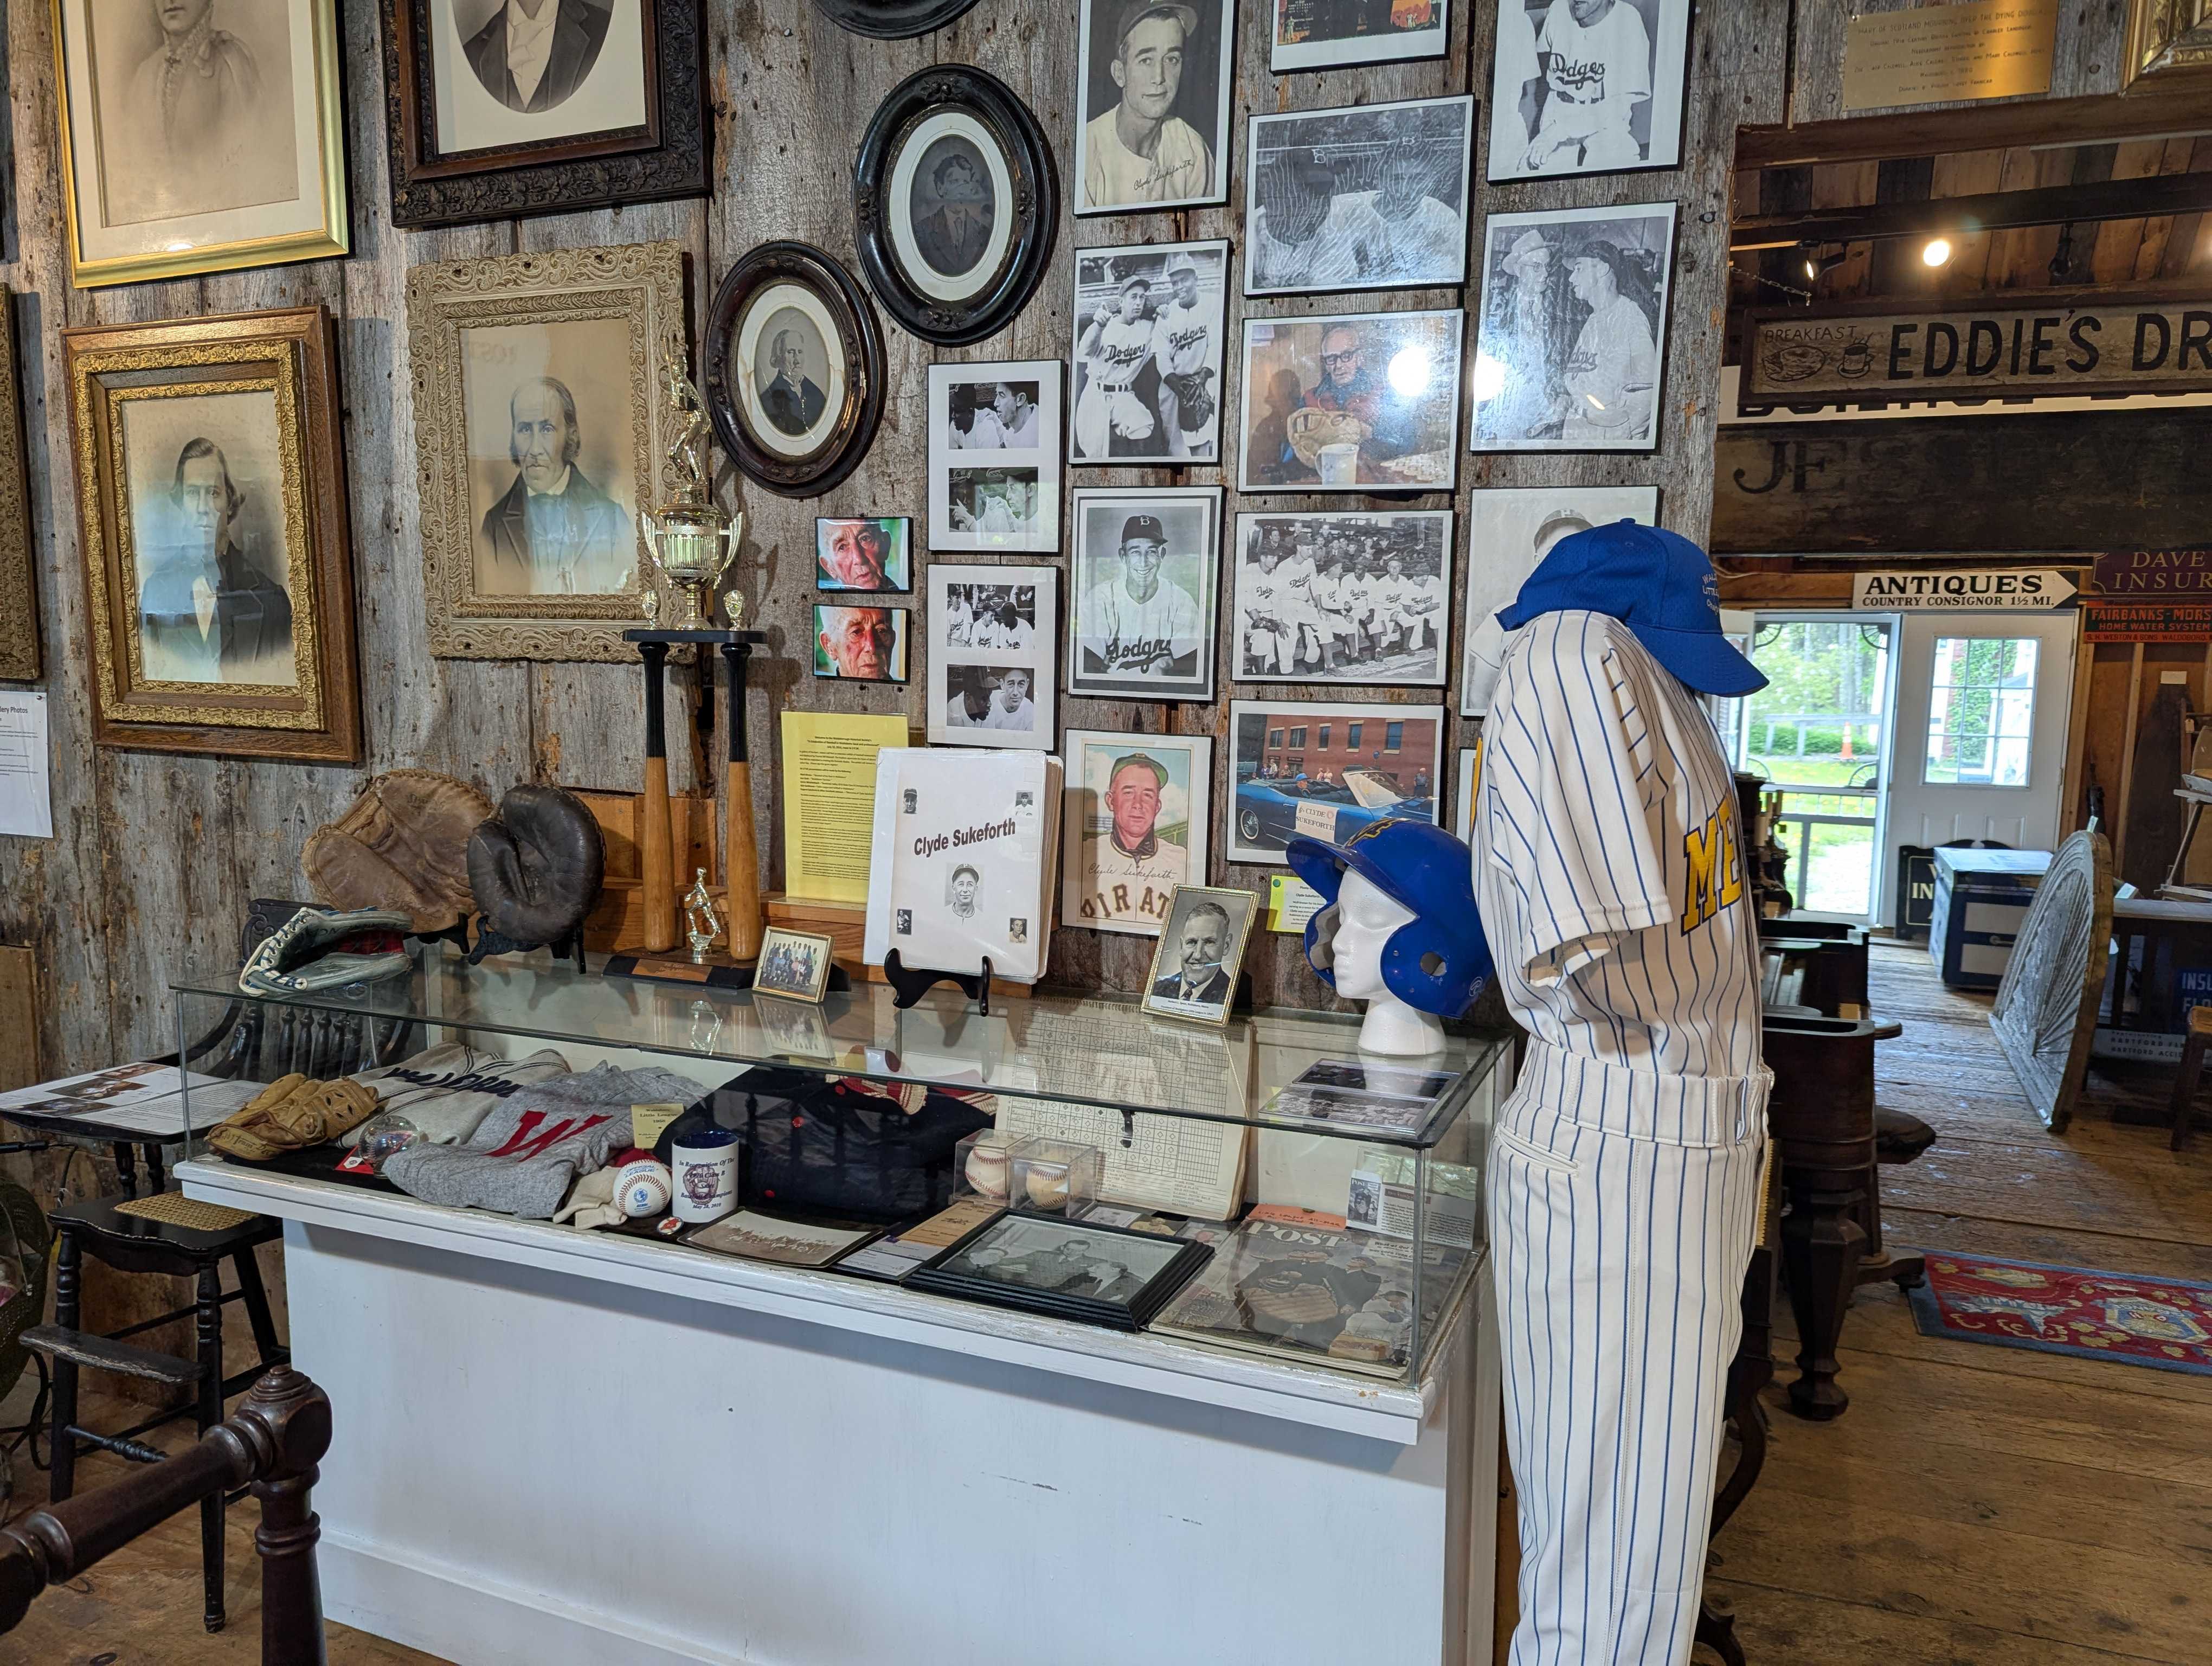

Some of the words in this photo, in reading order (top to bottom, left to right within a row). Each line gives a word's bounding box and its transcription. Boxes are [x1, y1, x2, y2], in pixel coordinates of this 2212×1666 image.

[1765, 325, 1858, 344] BREAKFAST
[1887, 309, 2103, 381] EDDIE'S
[1104, 343, 1146, 368] Dodgers
[1140, 516, 1150, 526] B
[2130, 550, 2207, 569] DAVE
[1864, 574, 2043, 596] ANTIQUES
[1862, 597, 1922, 607] COUNTRY
[1926, 595, 2003, 606] CONSIGNOR
[2130, 623, 2165, 631] WATER
[10, 706, 29, 714] Photos
[1305, 808, 1327, 818] CLYDE
[1295, 815, 1335, 831] SUKEFORTH
[914, 833, 949, 858] Clyde
[952, 817, 1016, 848] Sukeforth
[1088, 862, 1118, 881] Clyde
[1119, 863, 1178, 881] Sukeforth
[2111, 1037, 2163, 1046] HARTFORD
[2111, 1047, 2154, 1055] HARTFORD
[1246, 1220, 1348, 1247] POST
